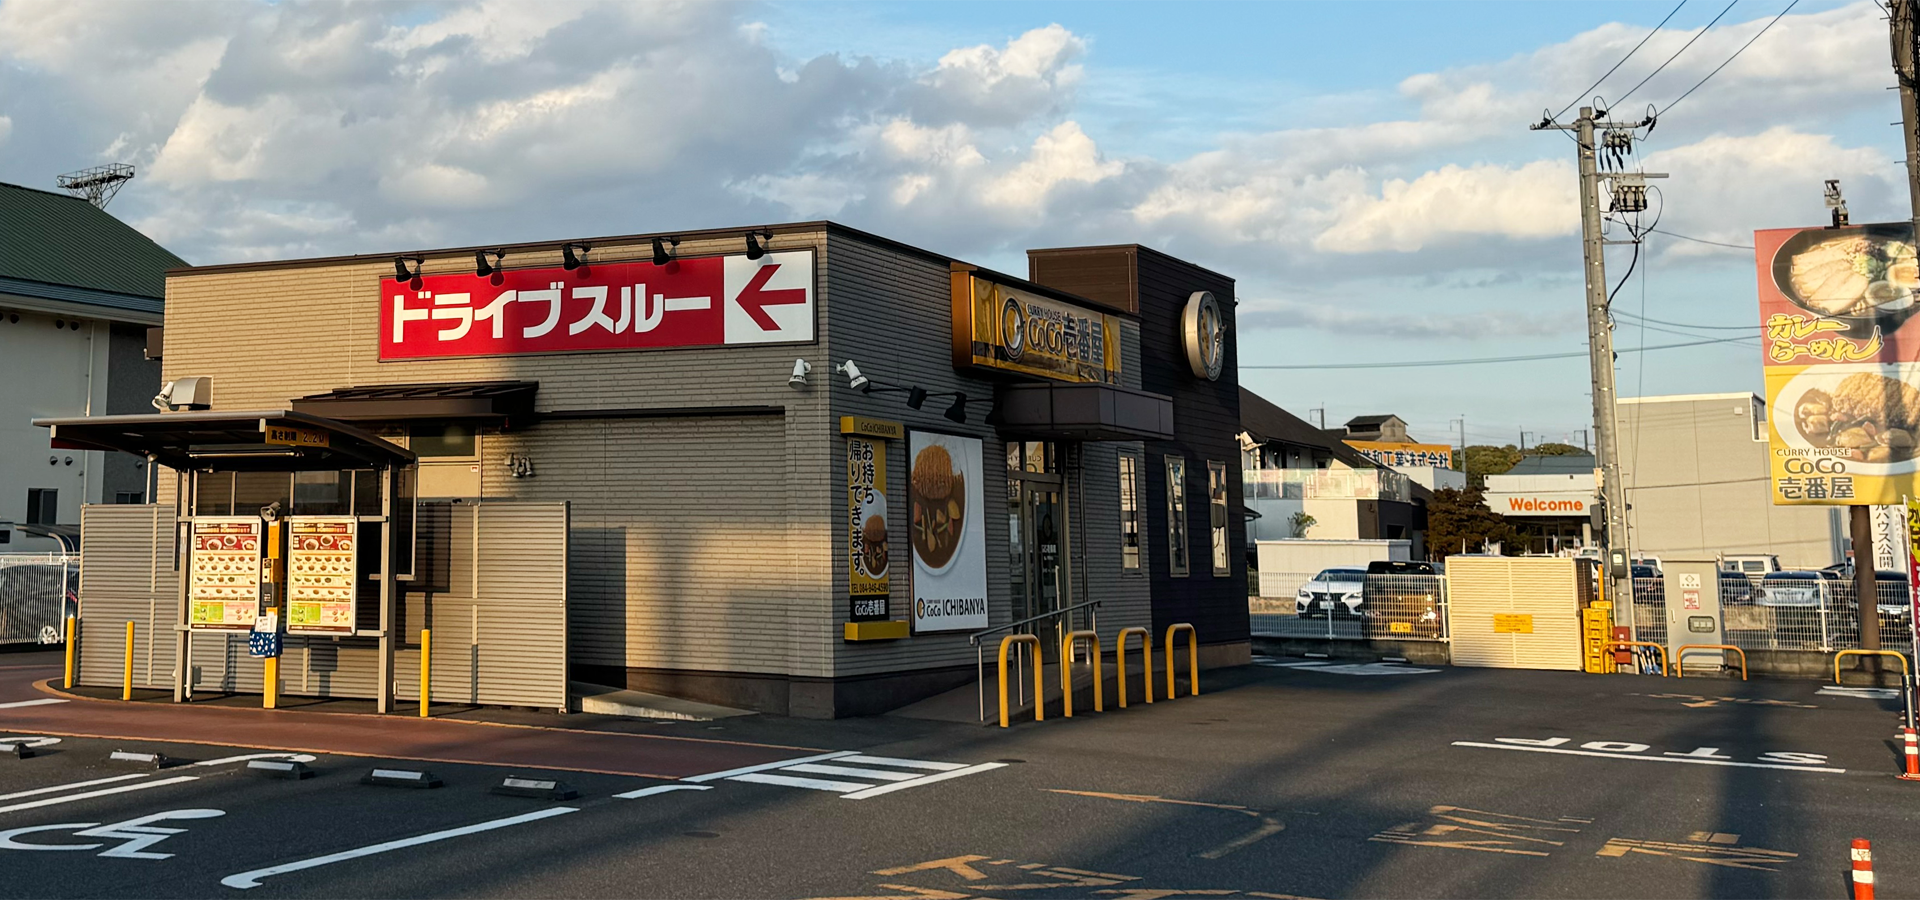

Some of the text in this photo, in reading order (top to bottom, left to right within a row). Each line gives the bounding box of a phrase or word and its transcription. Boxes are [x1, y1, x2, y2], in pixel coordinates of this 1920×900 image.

[393, 281, 711, 343] ドライブスルー
[1027, 304, 1062, 322] CURRY HOUSE
[1767, 313, 1850, 339] カレー
[1770, 325, 1884, 363] らーめん
[1776, 448, 1851, 457] CURRY HOUSE
[862, 441, 875, 504] お持ち
[1784, 458, 1846, 474] CoCo
[1778, 476, 1855, 499] 壱番屋
[849, 440, 865, 576] 帰りできます。
[1508, 497, 1584, 511] Welcome
[942, 598, 986, 616] ICHIBANYA
[1494, 736, 1828, 764] STOP
